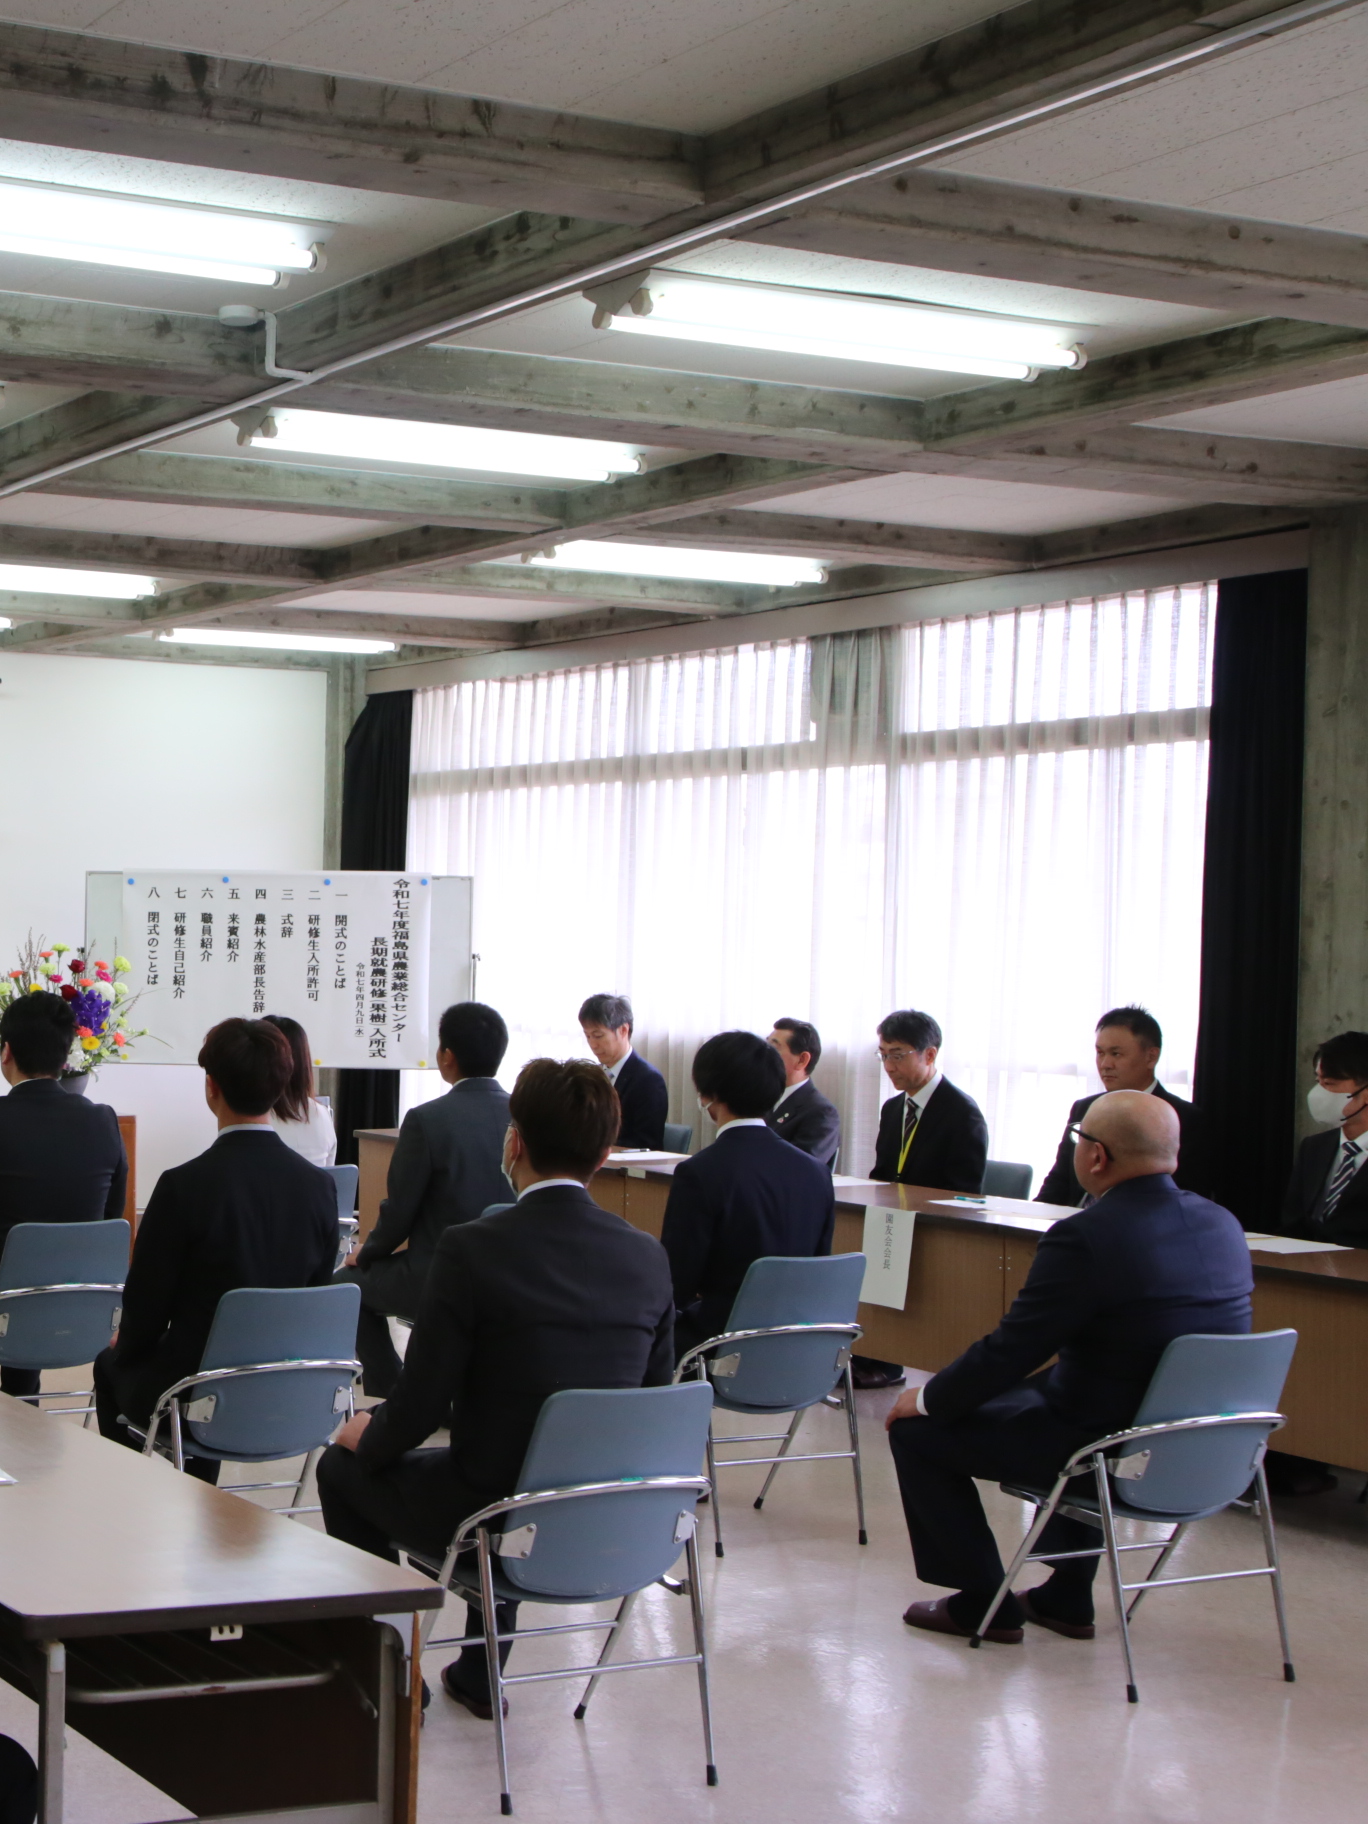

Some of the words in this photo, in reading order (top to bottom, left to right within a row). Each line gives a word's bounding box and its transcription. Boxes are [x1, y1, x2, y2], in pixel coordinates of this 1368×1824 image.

[148, 886, 160, 899] 八
[174, 887, 187, 899] 七
[201, 887, 213, 899] 六
[228, 888, 240, 900] 五
[255, 888, 267, 900] 四
[281, 888, 294, 900] 三
[308, 890, 321, 900] 二
[147, 911, 160, 986] 閉式のことば
[200, 912, 213, 962] 職員紹介
[227, 913, 240, 962] 来賓紹介
[281, 913, 294, 938] 式辞
[173, 912, 186, 999] 研修生自己紹介
[253, 913, 267, 1013] 農林水産部長告辞
[307, 914, 321, 1002] 研修生入所許可
[334, 914, 348, 989] 開式のことば
[391, 878, 411, 1043] 令和七年度福島県農業総合センター
[355, 962, 365, 1038] 令和七年四月九日(水)
[368, 936, 389, 1059] 長期就農研修(果樹)入所式
